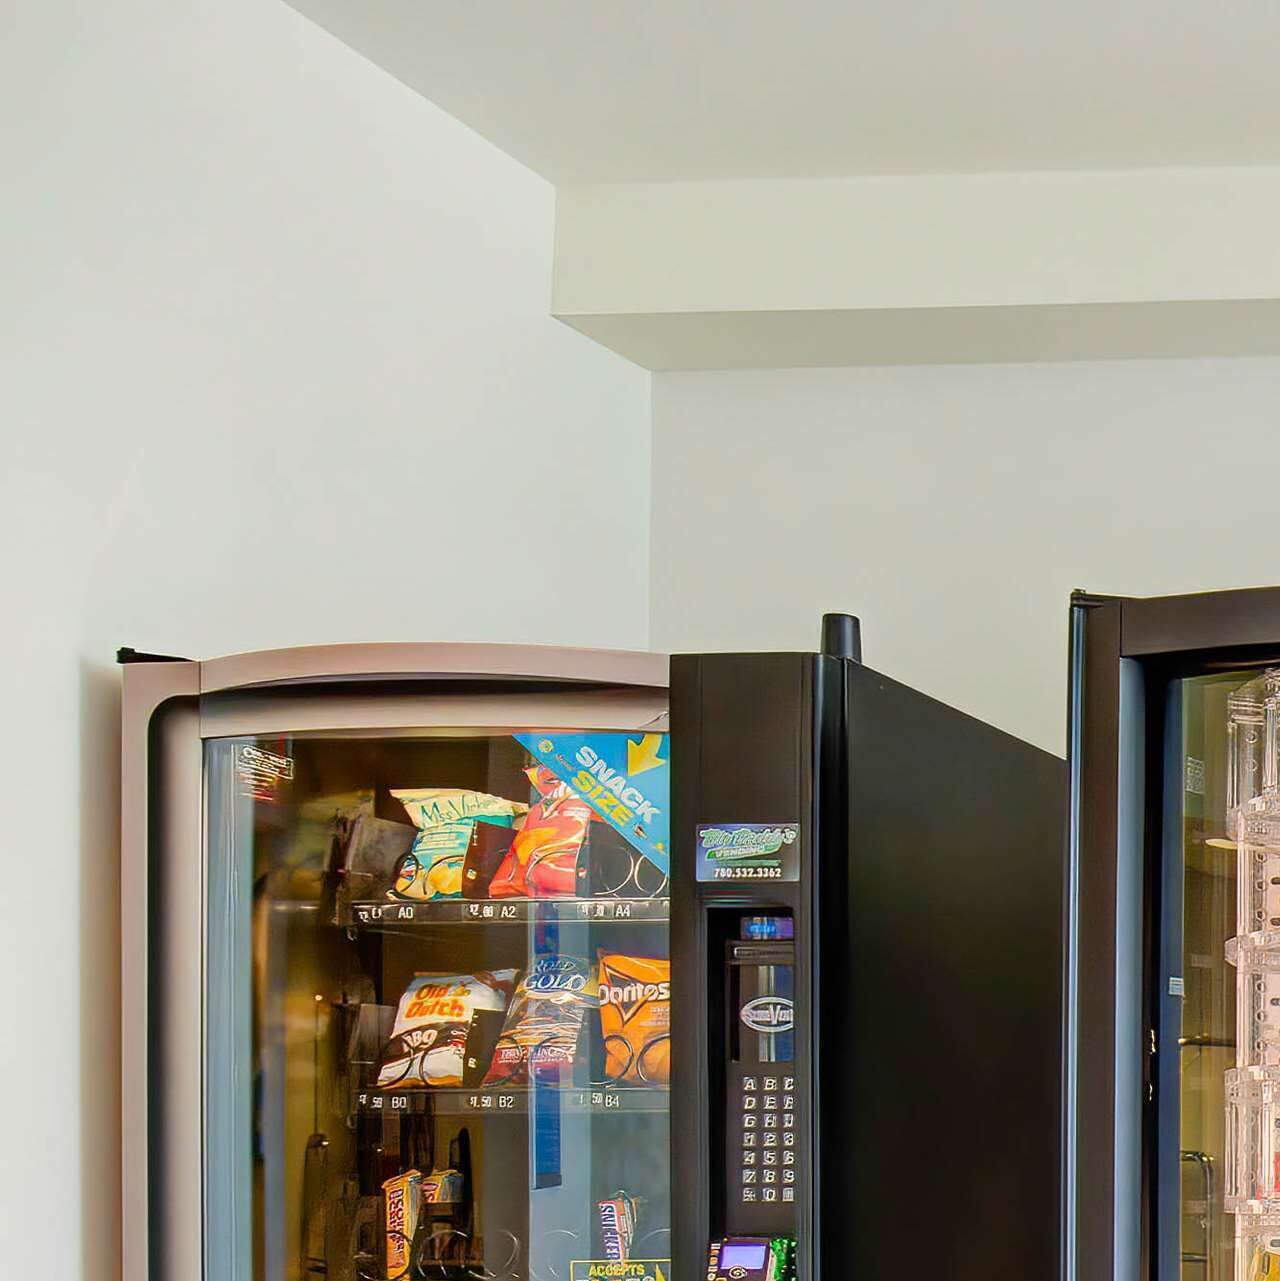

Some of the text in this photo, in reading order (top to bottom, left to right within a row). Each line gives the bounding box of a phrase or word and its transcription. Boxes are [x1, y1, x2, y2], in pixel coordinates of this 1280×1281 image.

[576, 746, 661, 824] SNACK
[572, 770, 634, 827] SIZE
[714, 868, 781, 878] 780.532.3362
[523, 974, 587, 991] GOLD
[404, 999, 464, 1018] Dutch
[499, 1096, 514, 1108] B2
[589, 1263, 645, 1276] ACCEPTS
